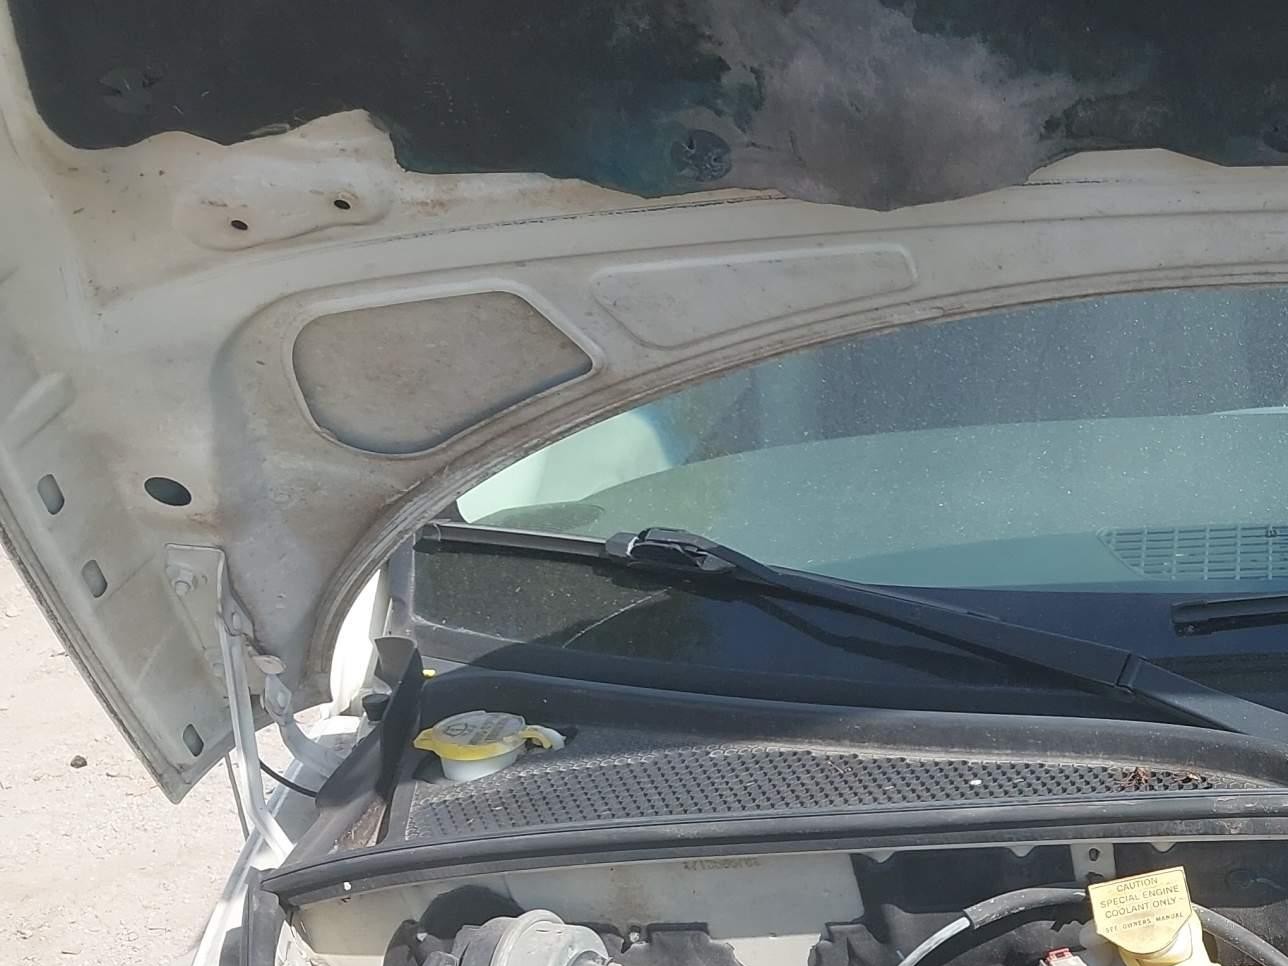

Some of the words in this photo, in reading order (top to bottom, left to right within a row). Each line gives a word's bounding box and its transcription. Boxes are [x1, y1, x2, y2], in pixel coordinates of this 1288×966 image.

[1116, 877, 1158, 892] CAUTION
[1100, 894, 1139, 909] SPECIAL
[1142, 884, 1180, 899] ENGINE
[1105, 902, 1150, 919] COOLANT
[1152, 896, 1177, 908] ONLY
[1155, 911, 1184, 922] MANUAL
